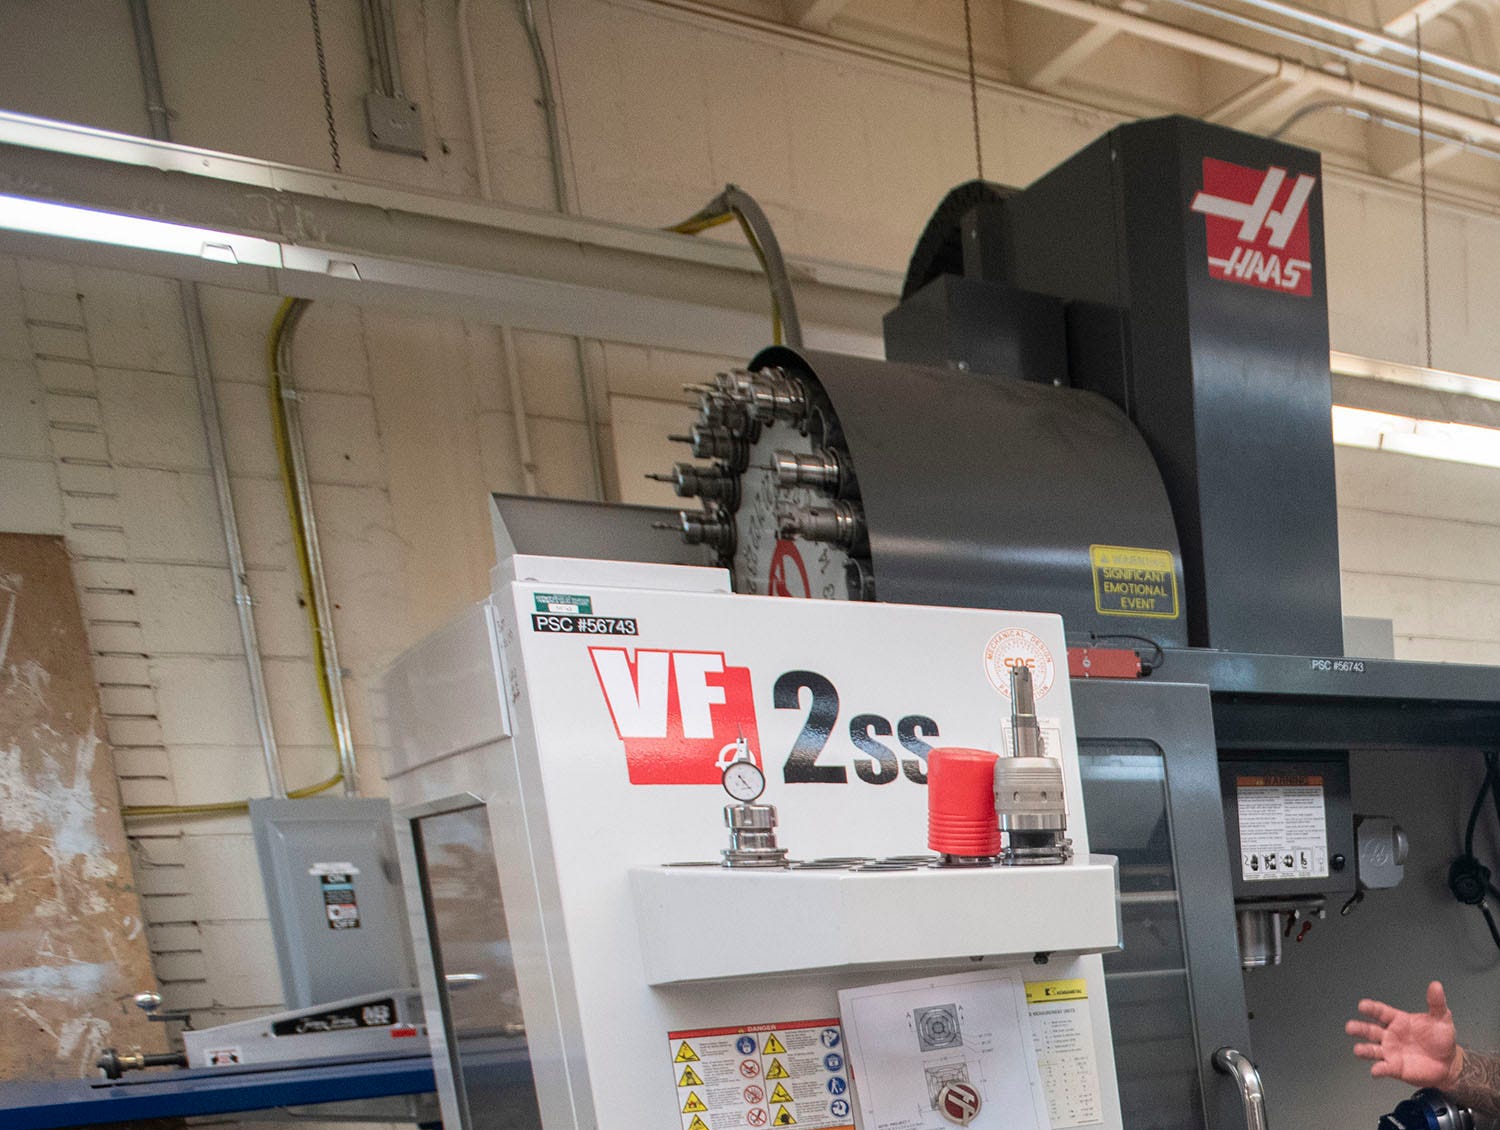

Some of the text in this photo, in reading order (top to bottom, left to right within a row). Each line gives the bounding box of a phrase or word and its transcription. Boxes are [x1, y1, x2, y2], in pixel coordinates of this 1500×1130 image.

[1208, 246, 1312, 288] HAAS
[1103, 567, 1165, 582] SIGNIFICANT
[1103, 581, 1167, 596] EMOTIONAL
[1121, 597, 1155, 608] EVENT
[537, 616, 636, 635] PSC #56743
[986, 630, 1051, 663] MECHANICAL DESIGN
[1312, 659, 1364, 671] PSC #56743
[588, 647, 726, 739] VF
[747, 1024, 776, 1033] DANGER
